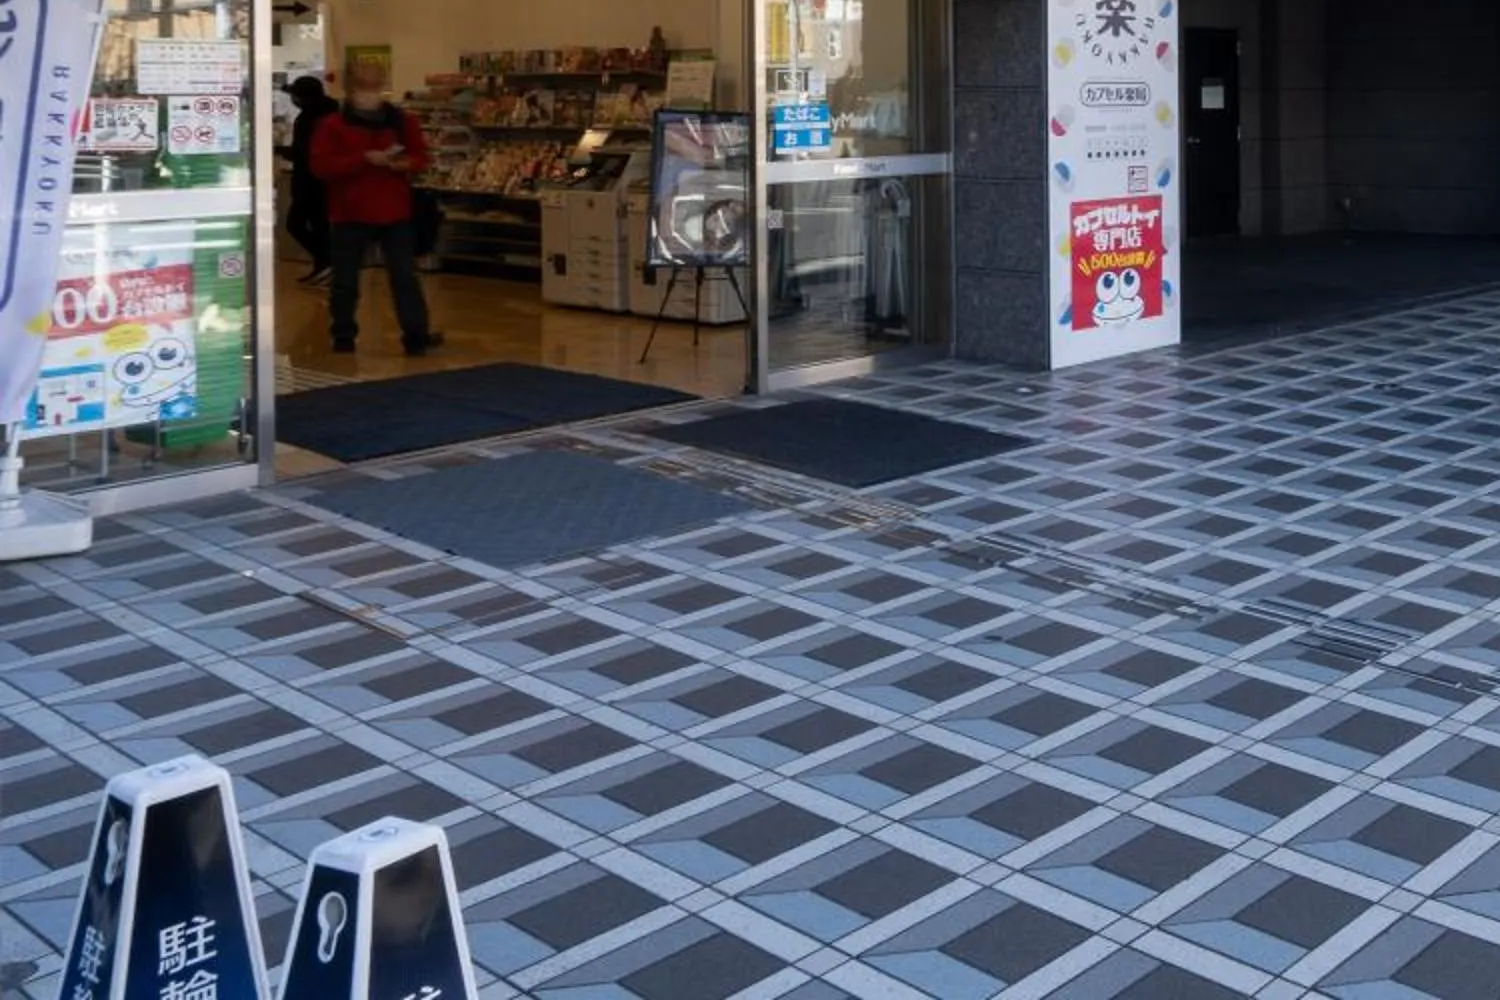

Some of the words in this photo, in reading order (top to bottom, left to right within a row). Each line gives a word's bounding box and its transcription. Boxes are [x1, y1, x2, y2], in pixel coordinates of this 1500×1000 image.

[1073, 203, 1160, 237] カプセルトイ
[1093, 226, 1142, 251] 専門店
[54, 282, 117, 329] 00
[72, 925, 106, 1000] 駐
